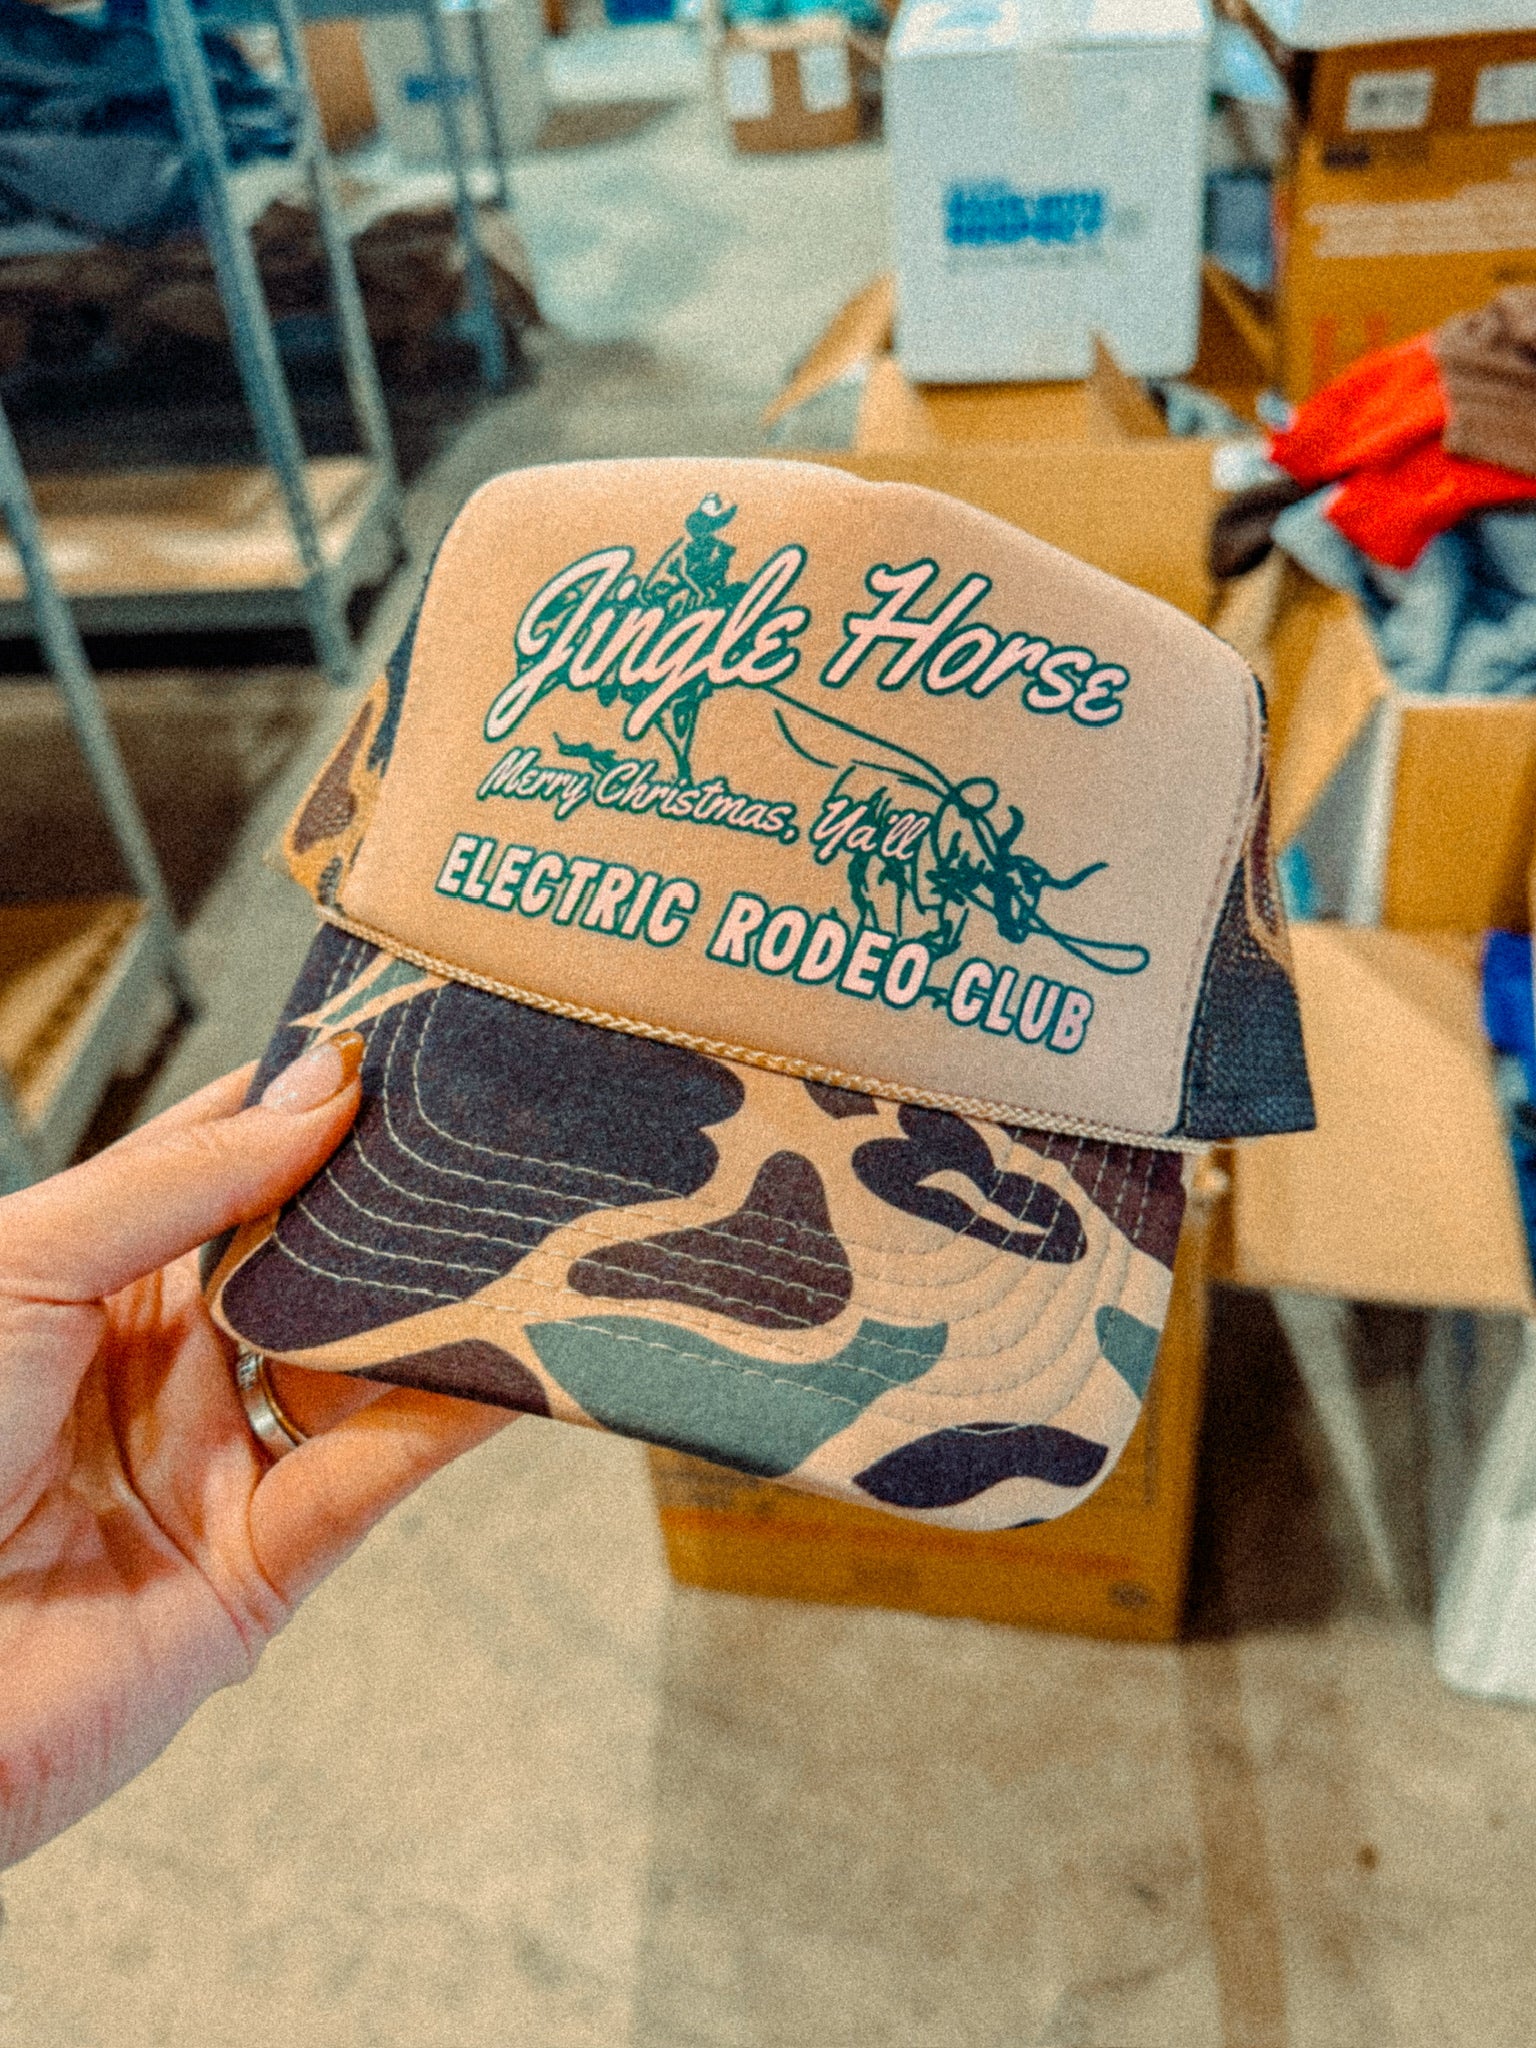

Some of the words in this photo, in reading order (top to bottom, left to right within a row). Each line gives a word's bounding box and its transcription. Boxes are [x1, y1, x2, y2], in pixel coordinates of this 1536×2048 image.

[484, 544, 808, 742] Jingle
[820, 556, 1130, 726] Horse
[477, 746, 592, 818] Merry
[592, 760, 799, 844] Christmas,
[811, 796, 931, 863] Ya'll
[435, 833, 701, 946] ELECTRIC
[708, 890, 931, 1008] RODEO
[947, 957, 1094, 1054] CLUB
